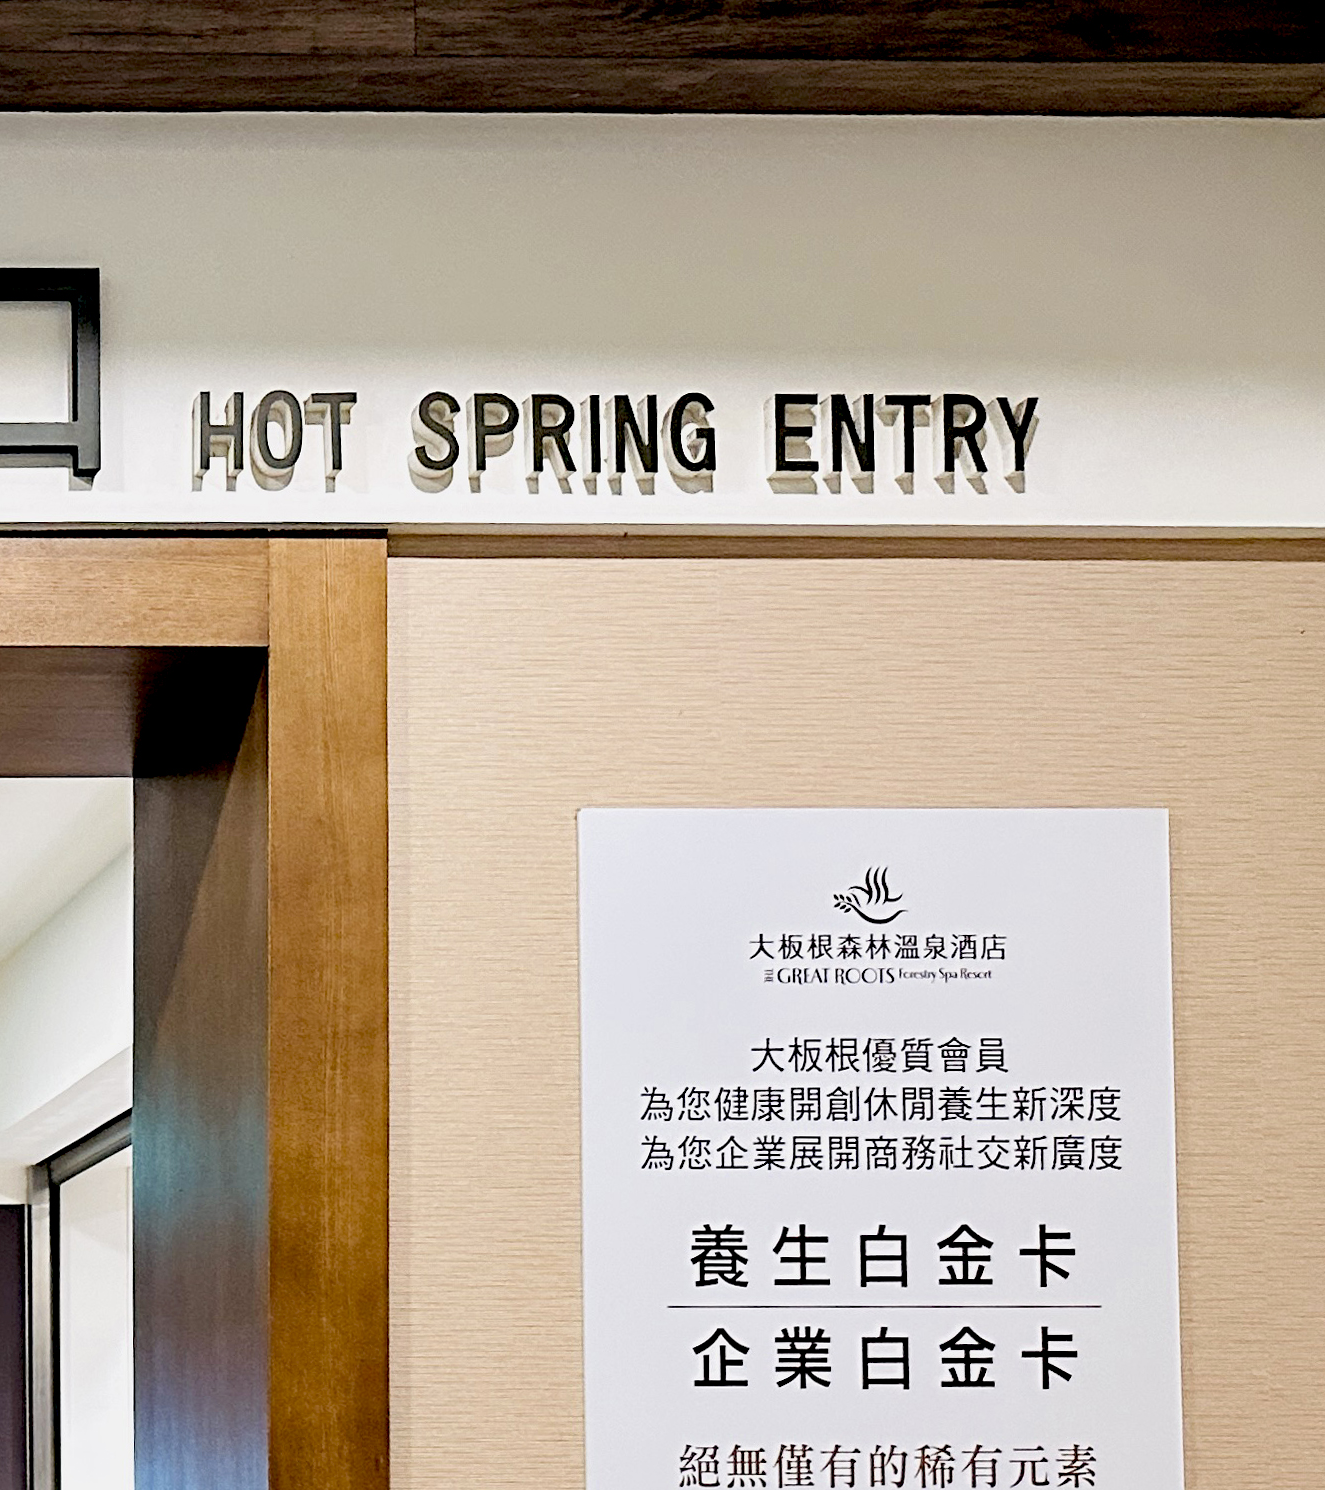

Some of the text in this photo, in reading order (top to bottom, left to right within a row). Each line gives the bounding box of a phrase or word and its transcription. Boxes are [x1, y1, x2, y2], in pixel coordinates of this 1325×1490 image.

[195, 390, 357, 480] HOT
[412, 391, 718, 482] SPRING
[772, 392, 1040, 482] ENTRY
[750, 934, 1006, 960] 大板根森林溫泉酒店
[777, 968, 828, 984] GREAT
[835, 968, 894, 984] ROOTS
[939, 968, 957, 982] Spa
[961, 969, 991, 979] Resort
[751, 1037, 1008, 1072] 大板根優質會員
[641, 1086, 1121, 1121] 為您健康開創休閒養生新深度
[642, 1135, 1122, 1170] 為您企業展開商務社交新廣度
[691, 1224, 1075, 1287] 養生白金卡
[693, 1326, 1077, 1390] 企業白金卡
[680, 1444, 1096, 1488] 絕無僅有的稀有元素
